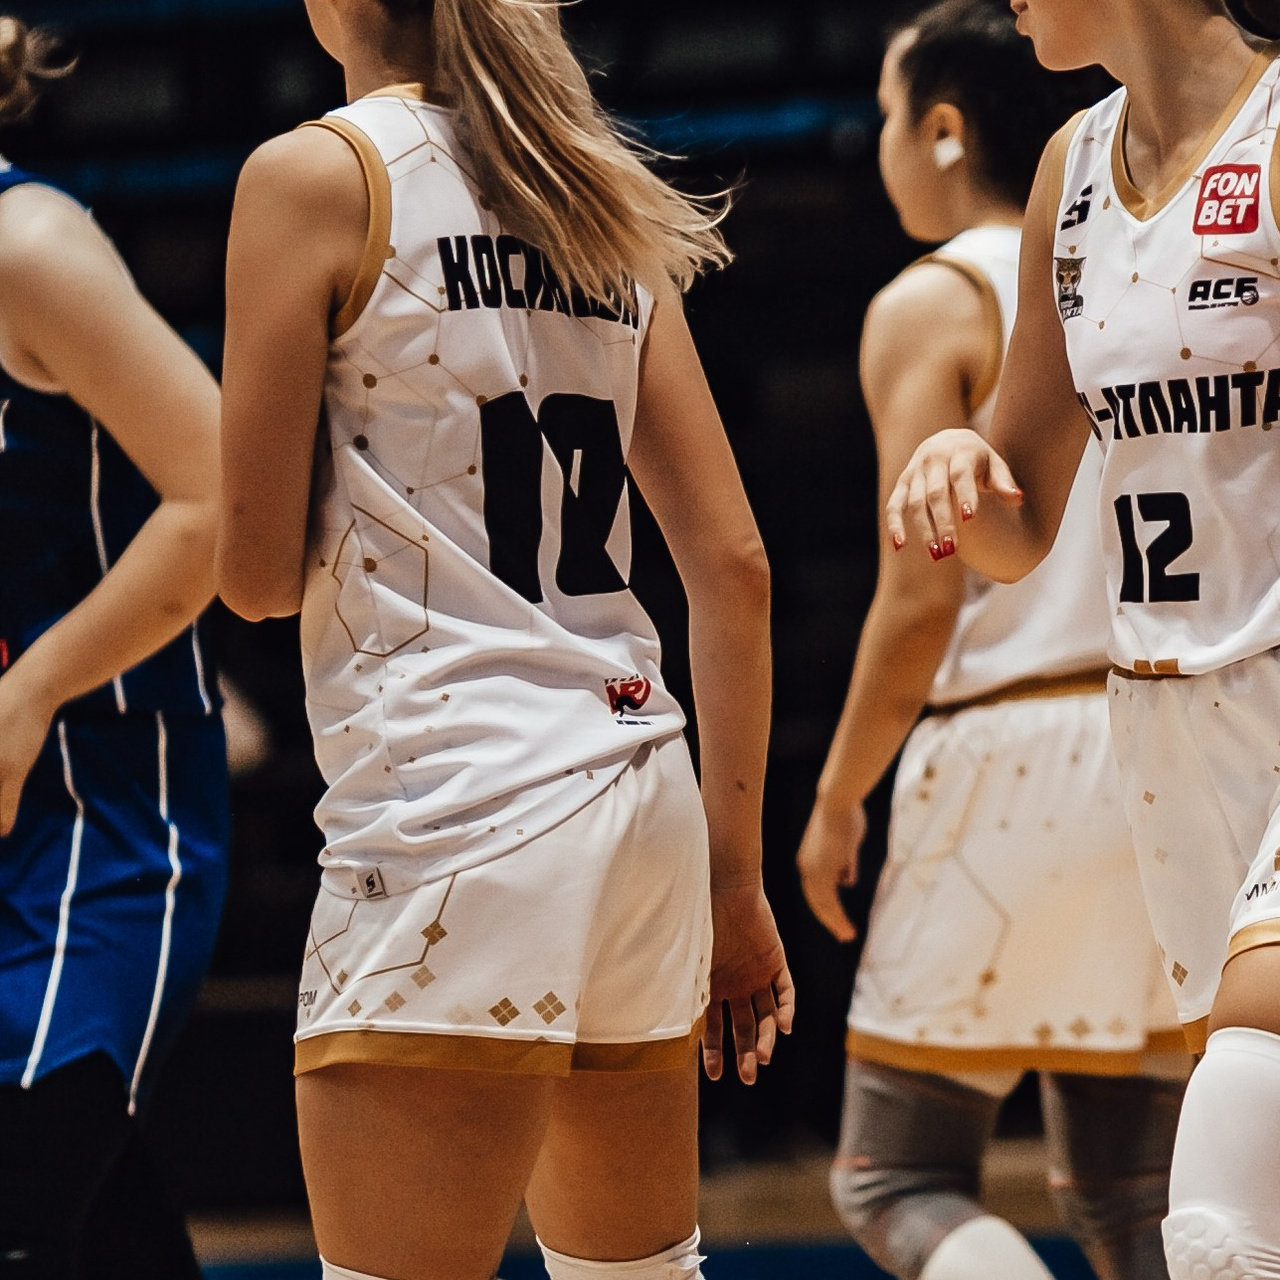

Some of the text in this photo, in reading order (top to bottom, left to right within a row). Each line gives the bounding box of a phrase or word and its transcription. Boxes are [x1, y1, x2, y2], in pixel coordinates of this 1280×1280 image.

[1202, 171, 1259, 198] FON
[1197, 197, 1255, 227] BET
[1113, 492, 1201, 604] 12
